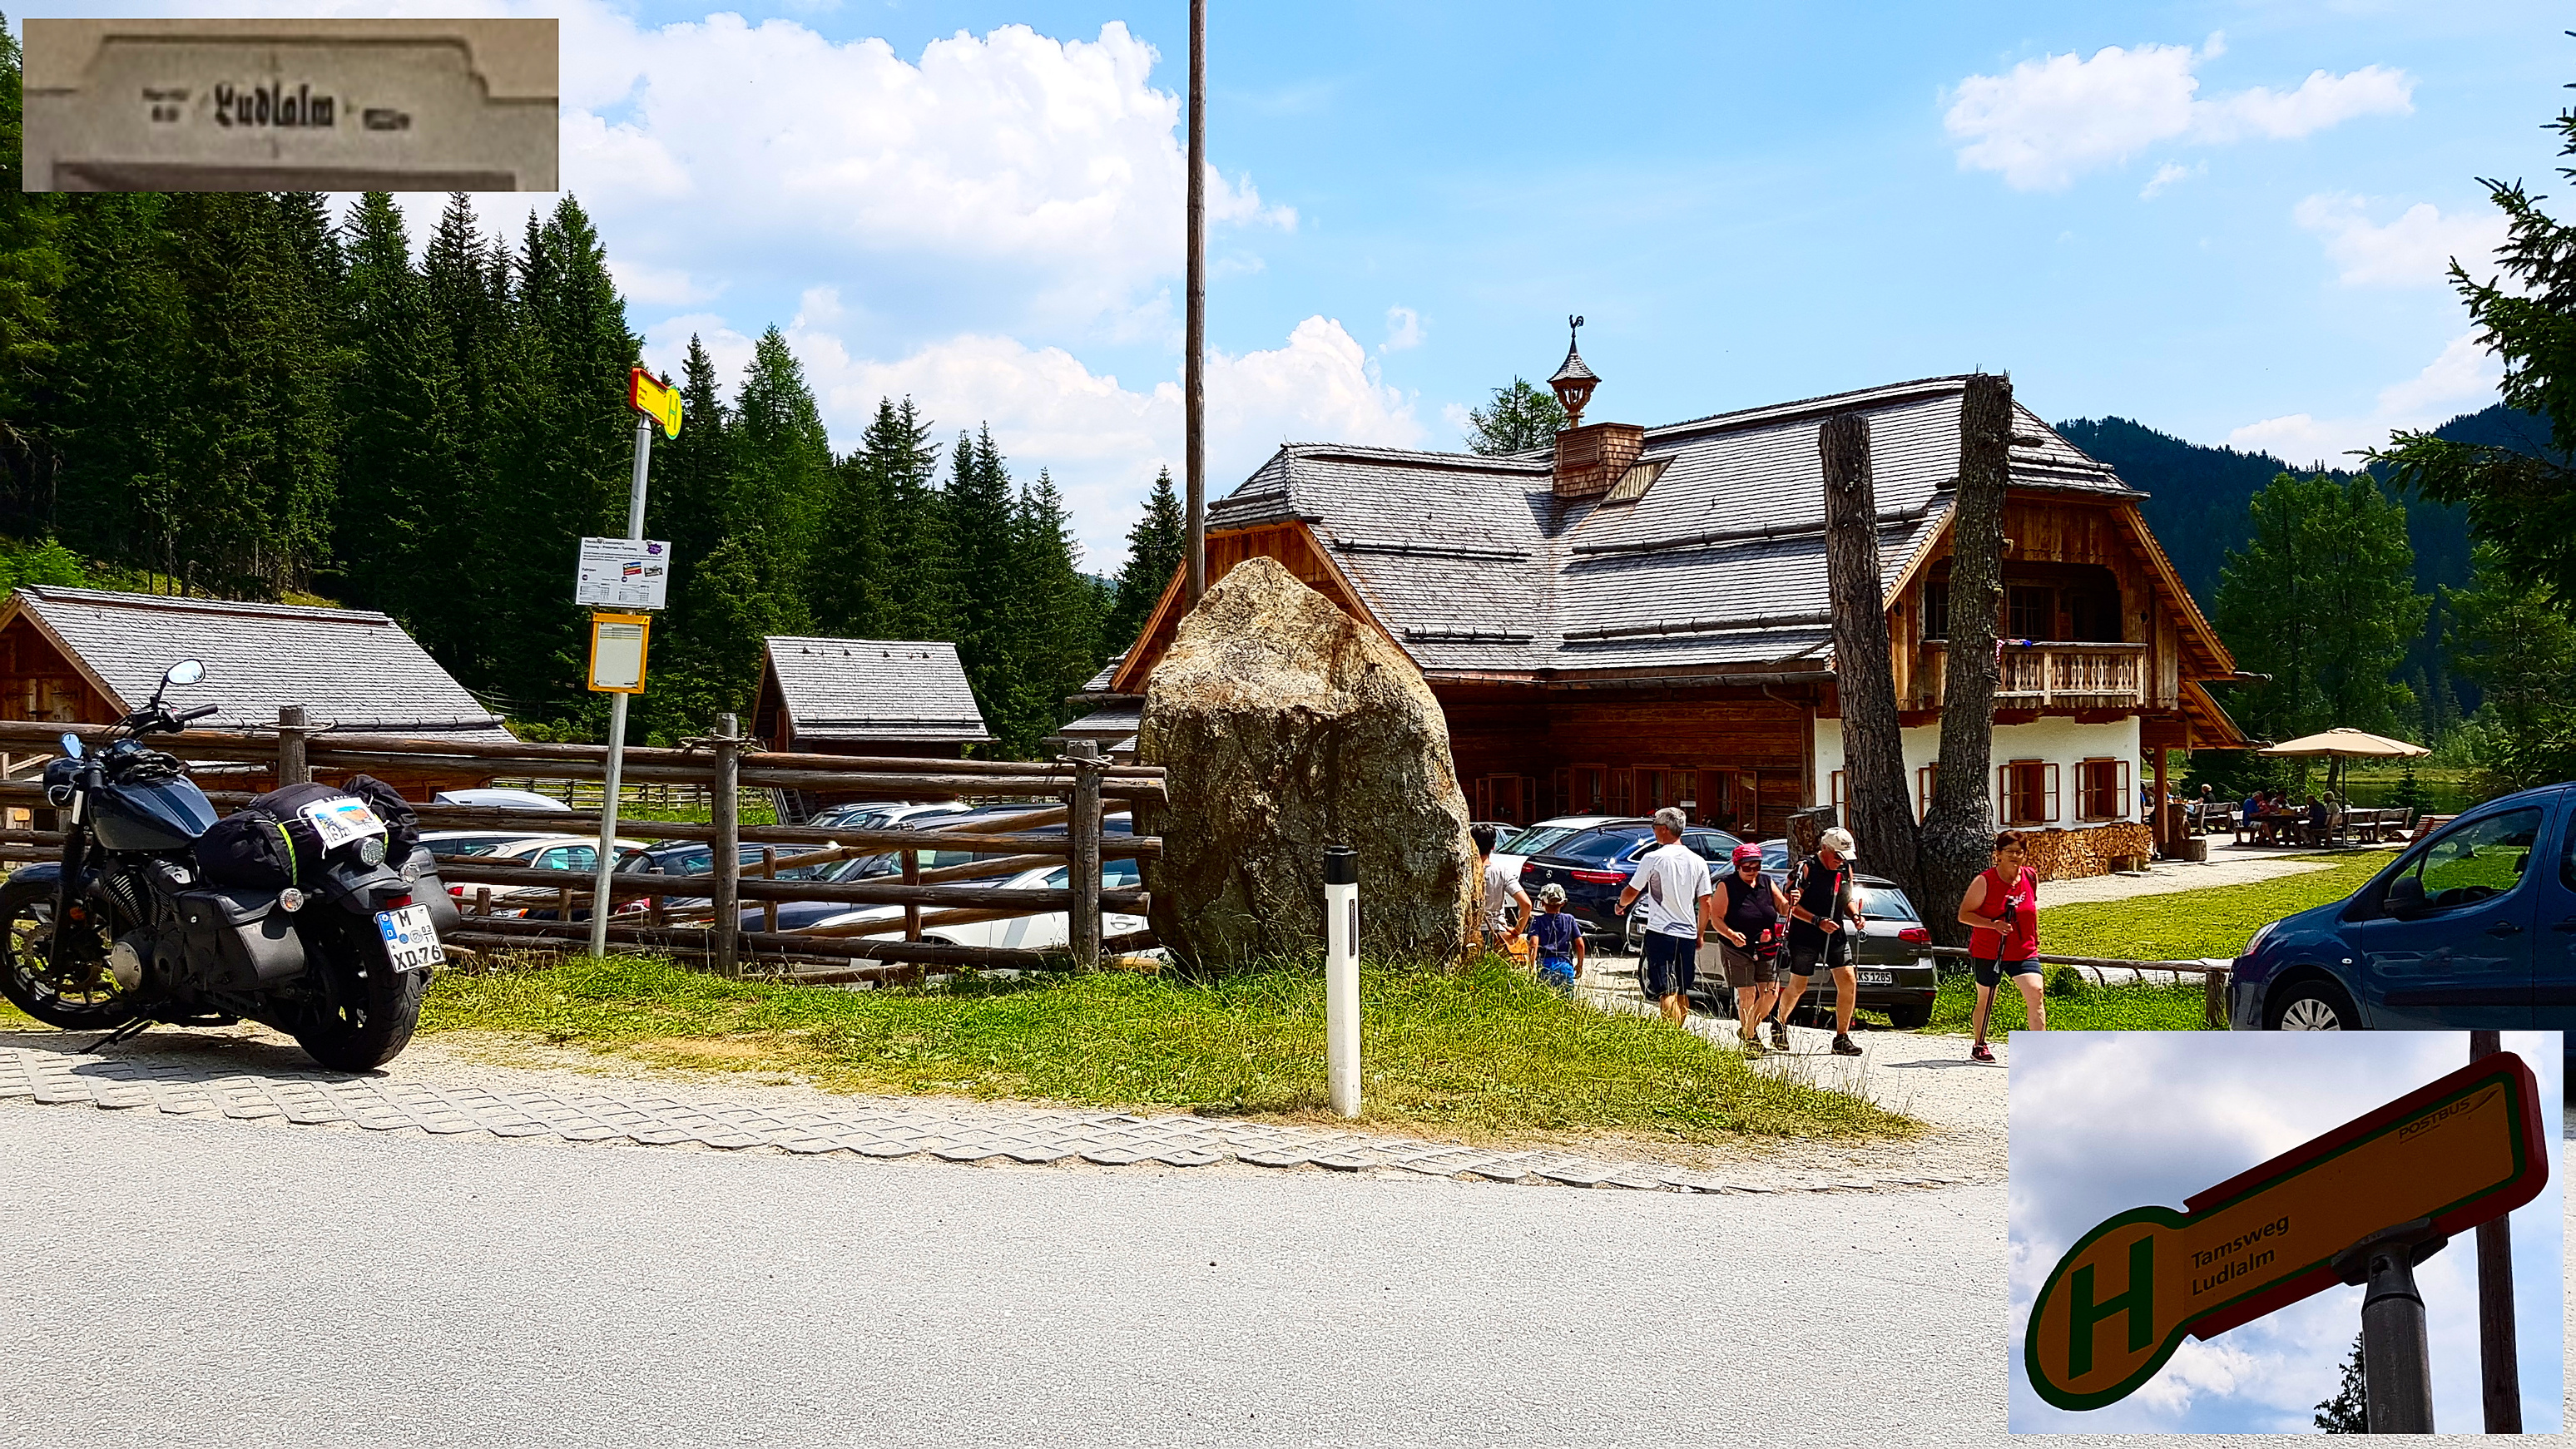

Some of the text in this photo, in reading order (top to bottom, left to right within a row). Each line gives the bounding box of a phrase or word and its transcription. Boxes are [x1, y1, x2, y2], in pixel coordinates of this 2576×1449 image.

[666, 394, 679, 431] H
[386, 929, 394, 937] D
[397, 910, 412, 927] M
[1870, 972, 1891, 982] 1285
[2398, 1097, 2471, 1140] POSTBUS
[2190, 1216, 2290, 1270] Tamsweg
[2192, 1249, 2276, 1297] Ludlalm
[2068, 1234, 2154, 1382] H
